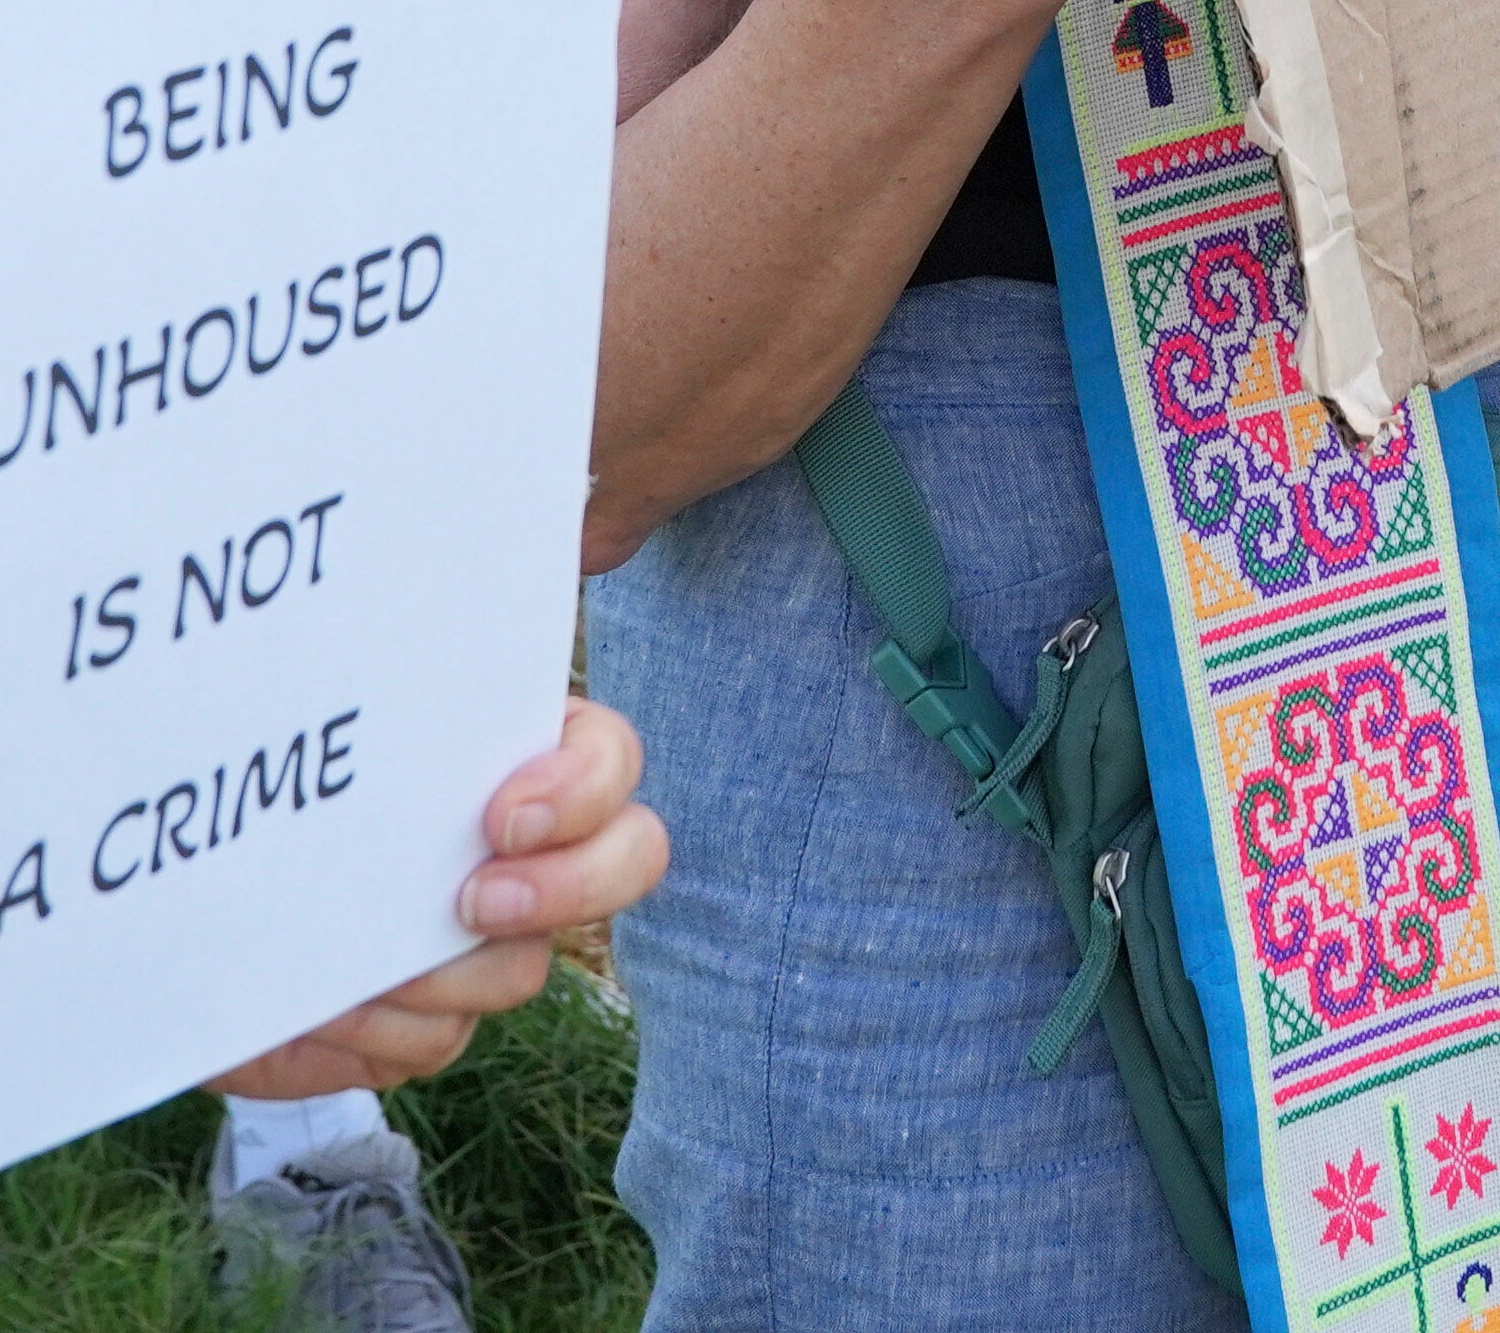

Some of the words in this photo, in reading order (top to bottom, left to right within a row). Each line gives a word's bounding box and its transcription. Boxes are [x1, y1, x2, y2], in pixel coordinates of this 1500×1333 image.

[102, 25, 360, 181] BEING
[63, 574, 142, 683] IS
[171, 493, 345, 643] NOT
[90, 707, 361, 894] CRIME
